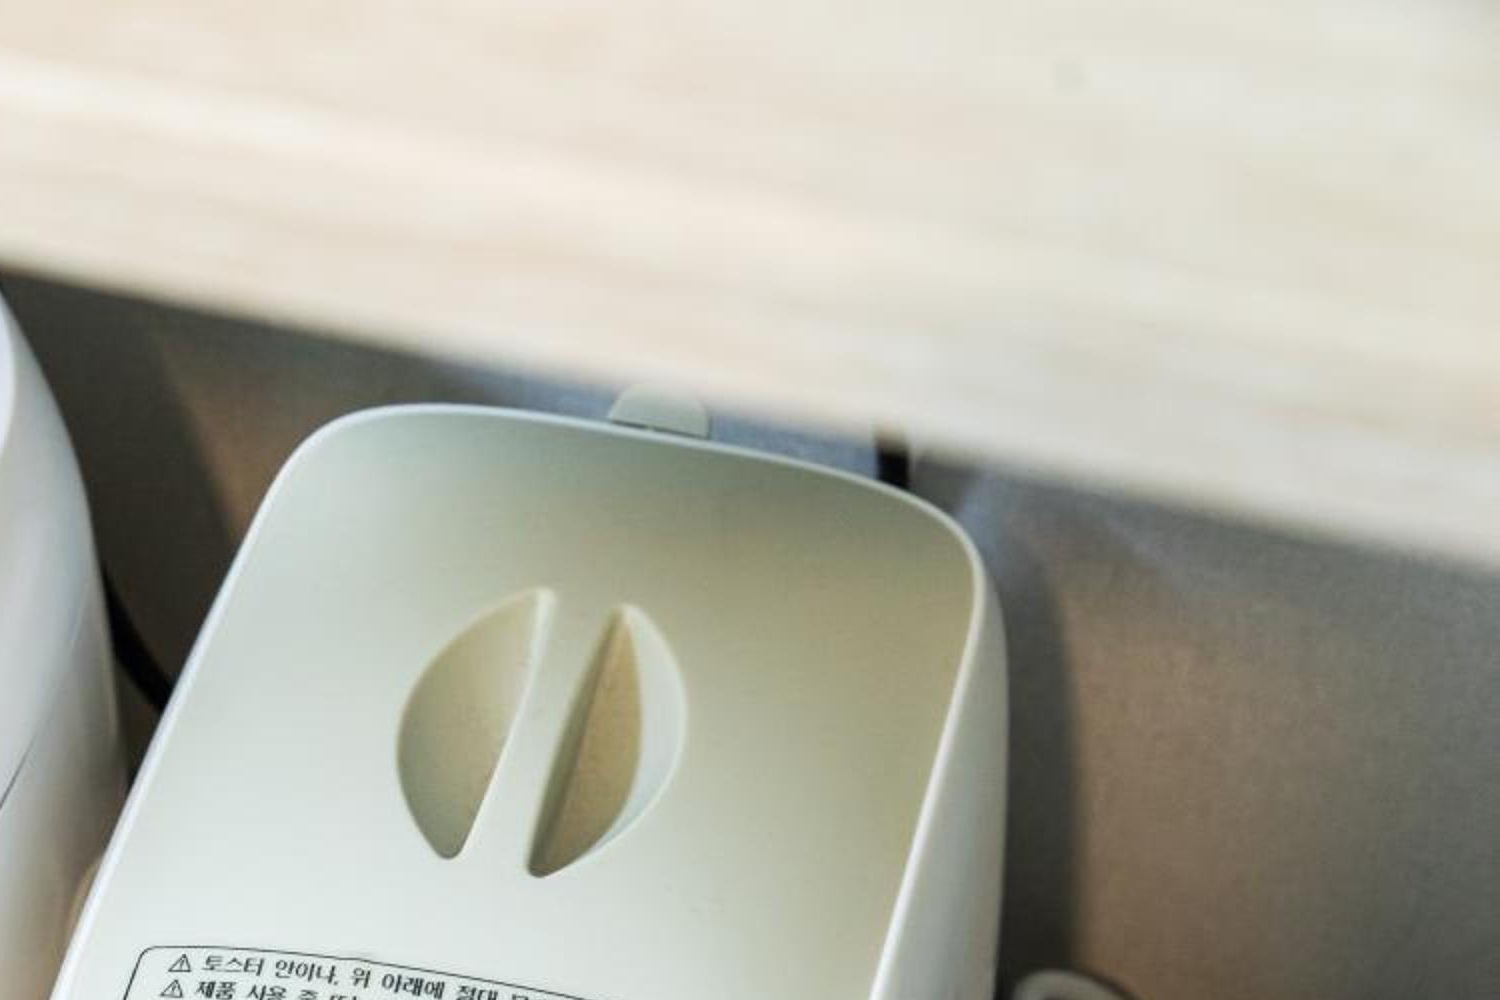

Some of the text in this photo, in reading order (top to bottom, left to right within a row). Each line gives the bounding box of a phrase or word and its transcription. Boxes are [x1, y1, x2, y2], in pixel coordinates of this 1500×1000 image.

[201, 955, 265, 977] 토스터
[352, 967, 372, 989] 위
[194, 980, 237, 1000] 제품
